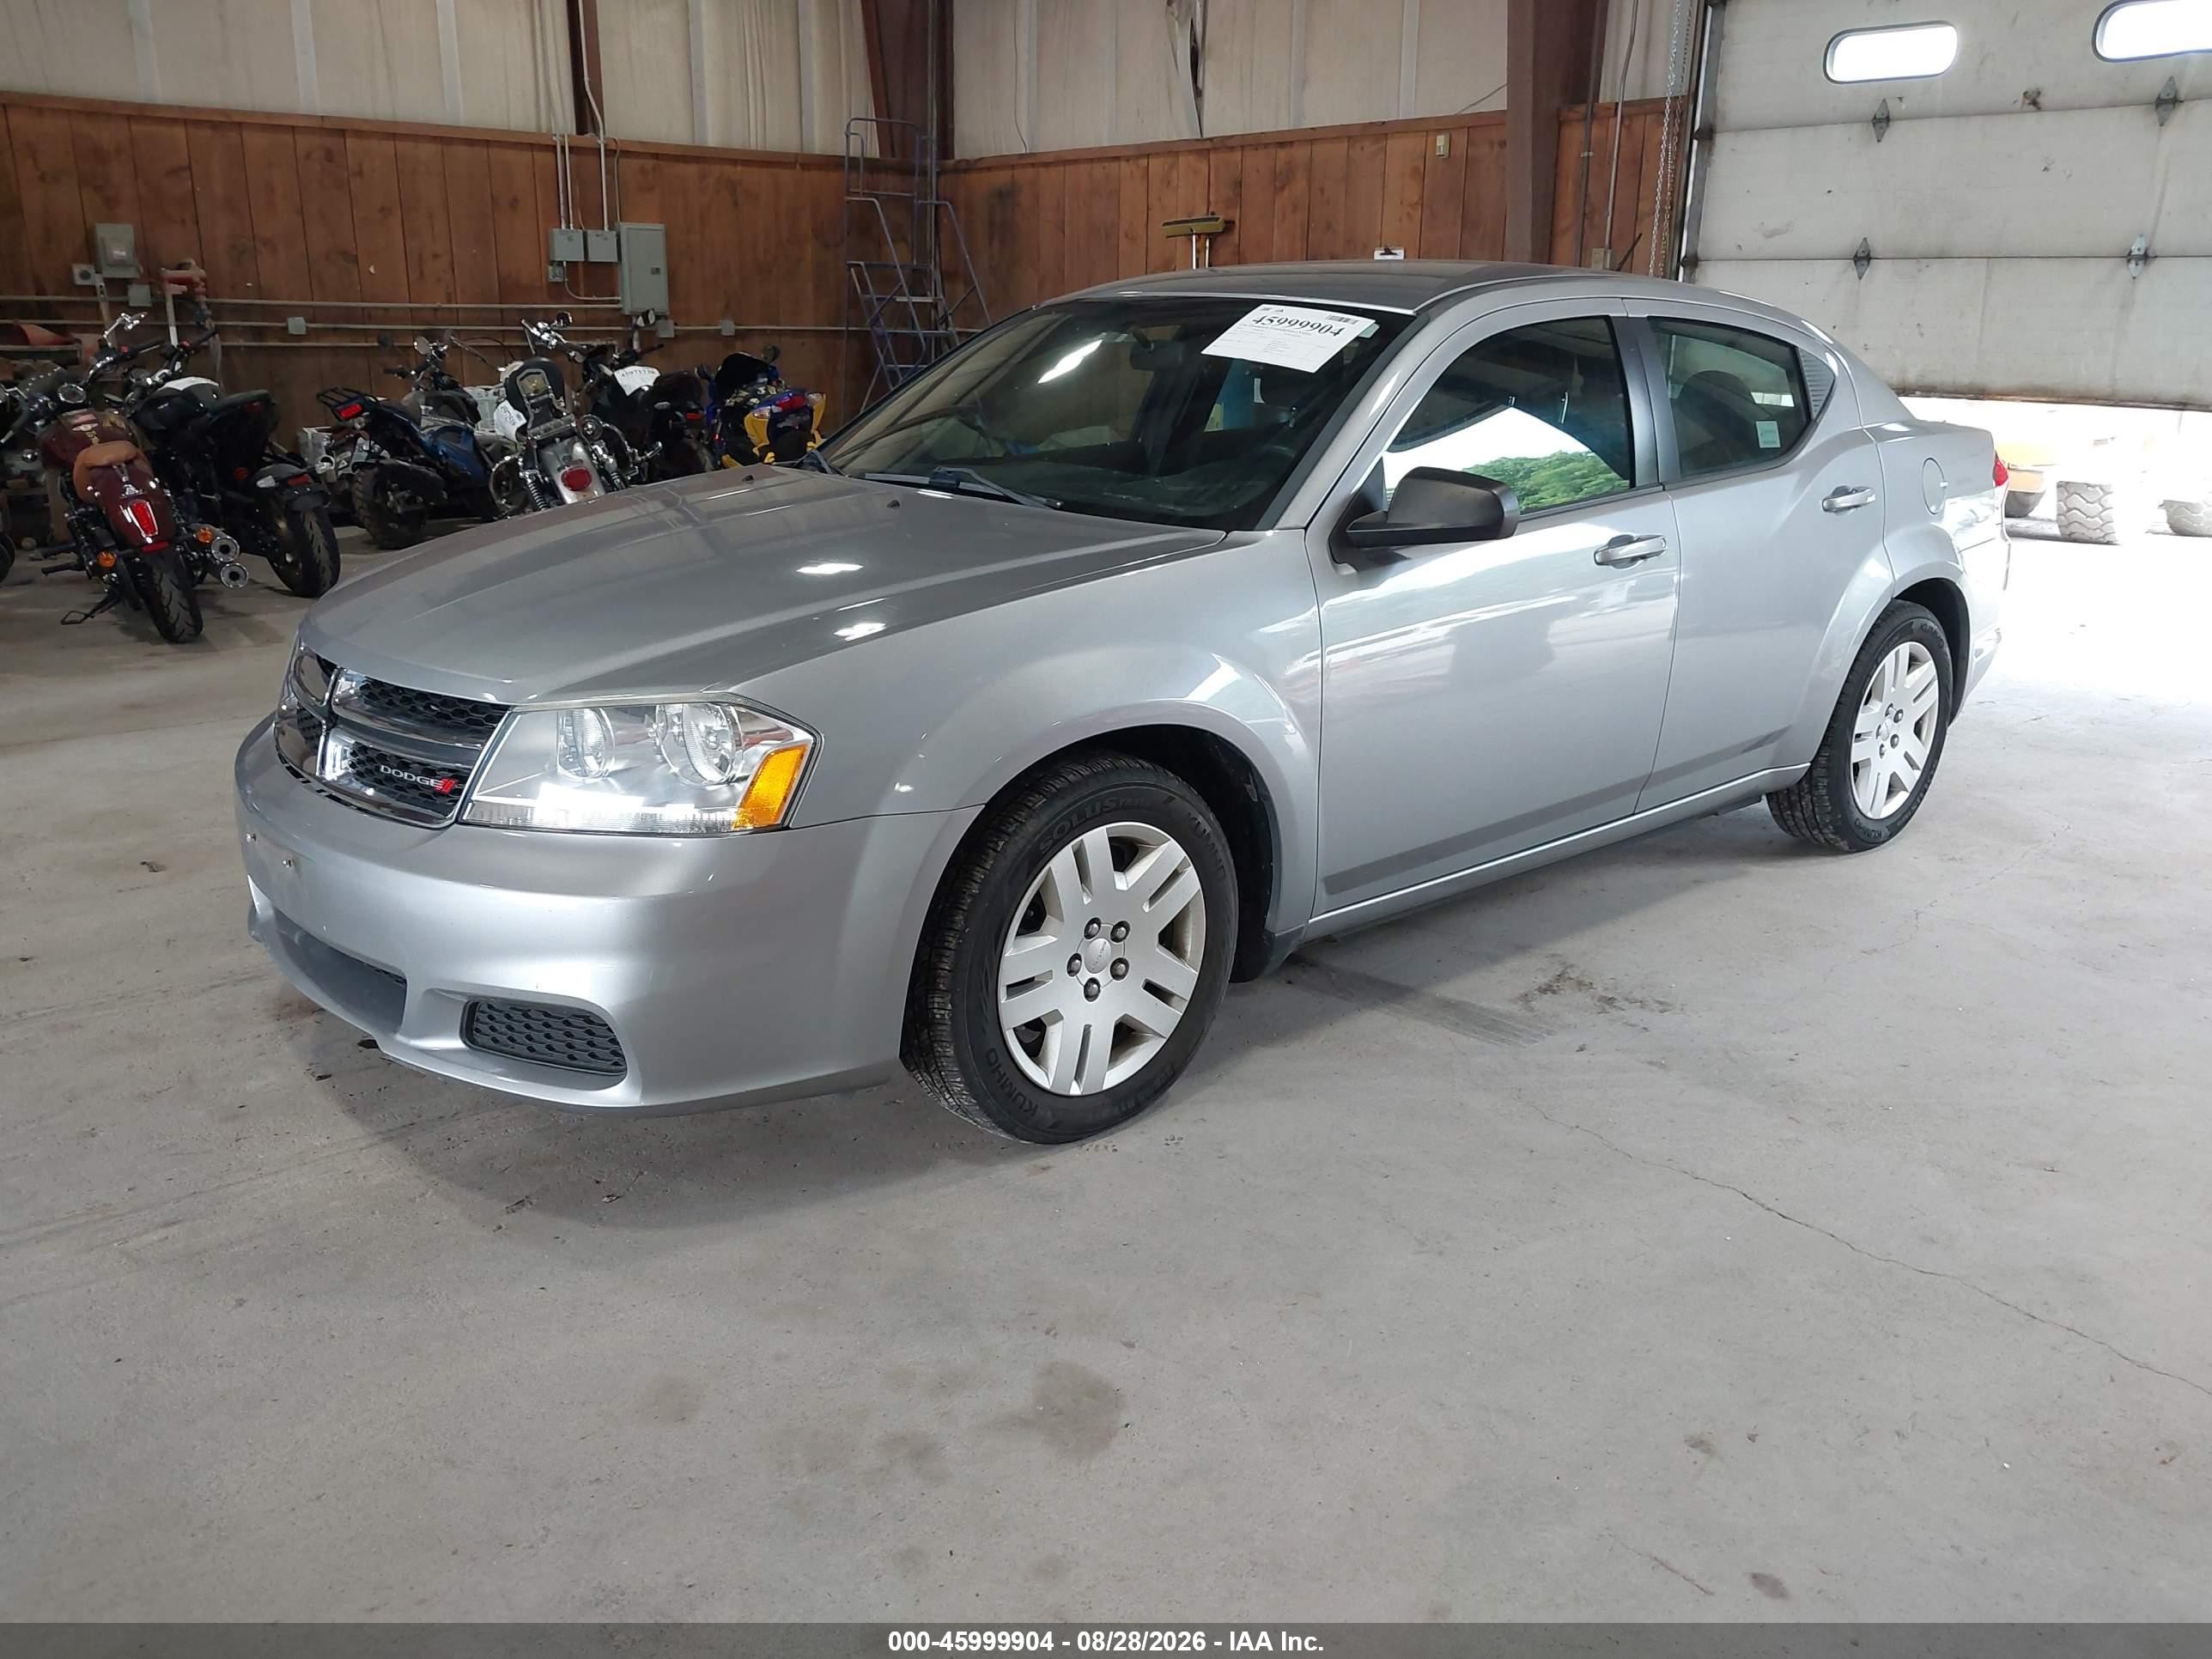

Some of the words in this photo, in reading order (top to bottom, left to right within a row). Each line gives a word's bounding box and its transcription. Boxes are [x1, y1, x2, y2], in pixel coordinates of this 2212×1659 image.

[1251, 315, 1346, 337] 45999904
[380, 764, 443, 788] DODGE
[1039, 796, 1117, 854] SOLUS
[985, 1048, 1038, 1116] KUMHO
